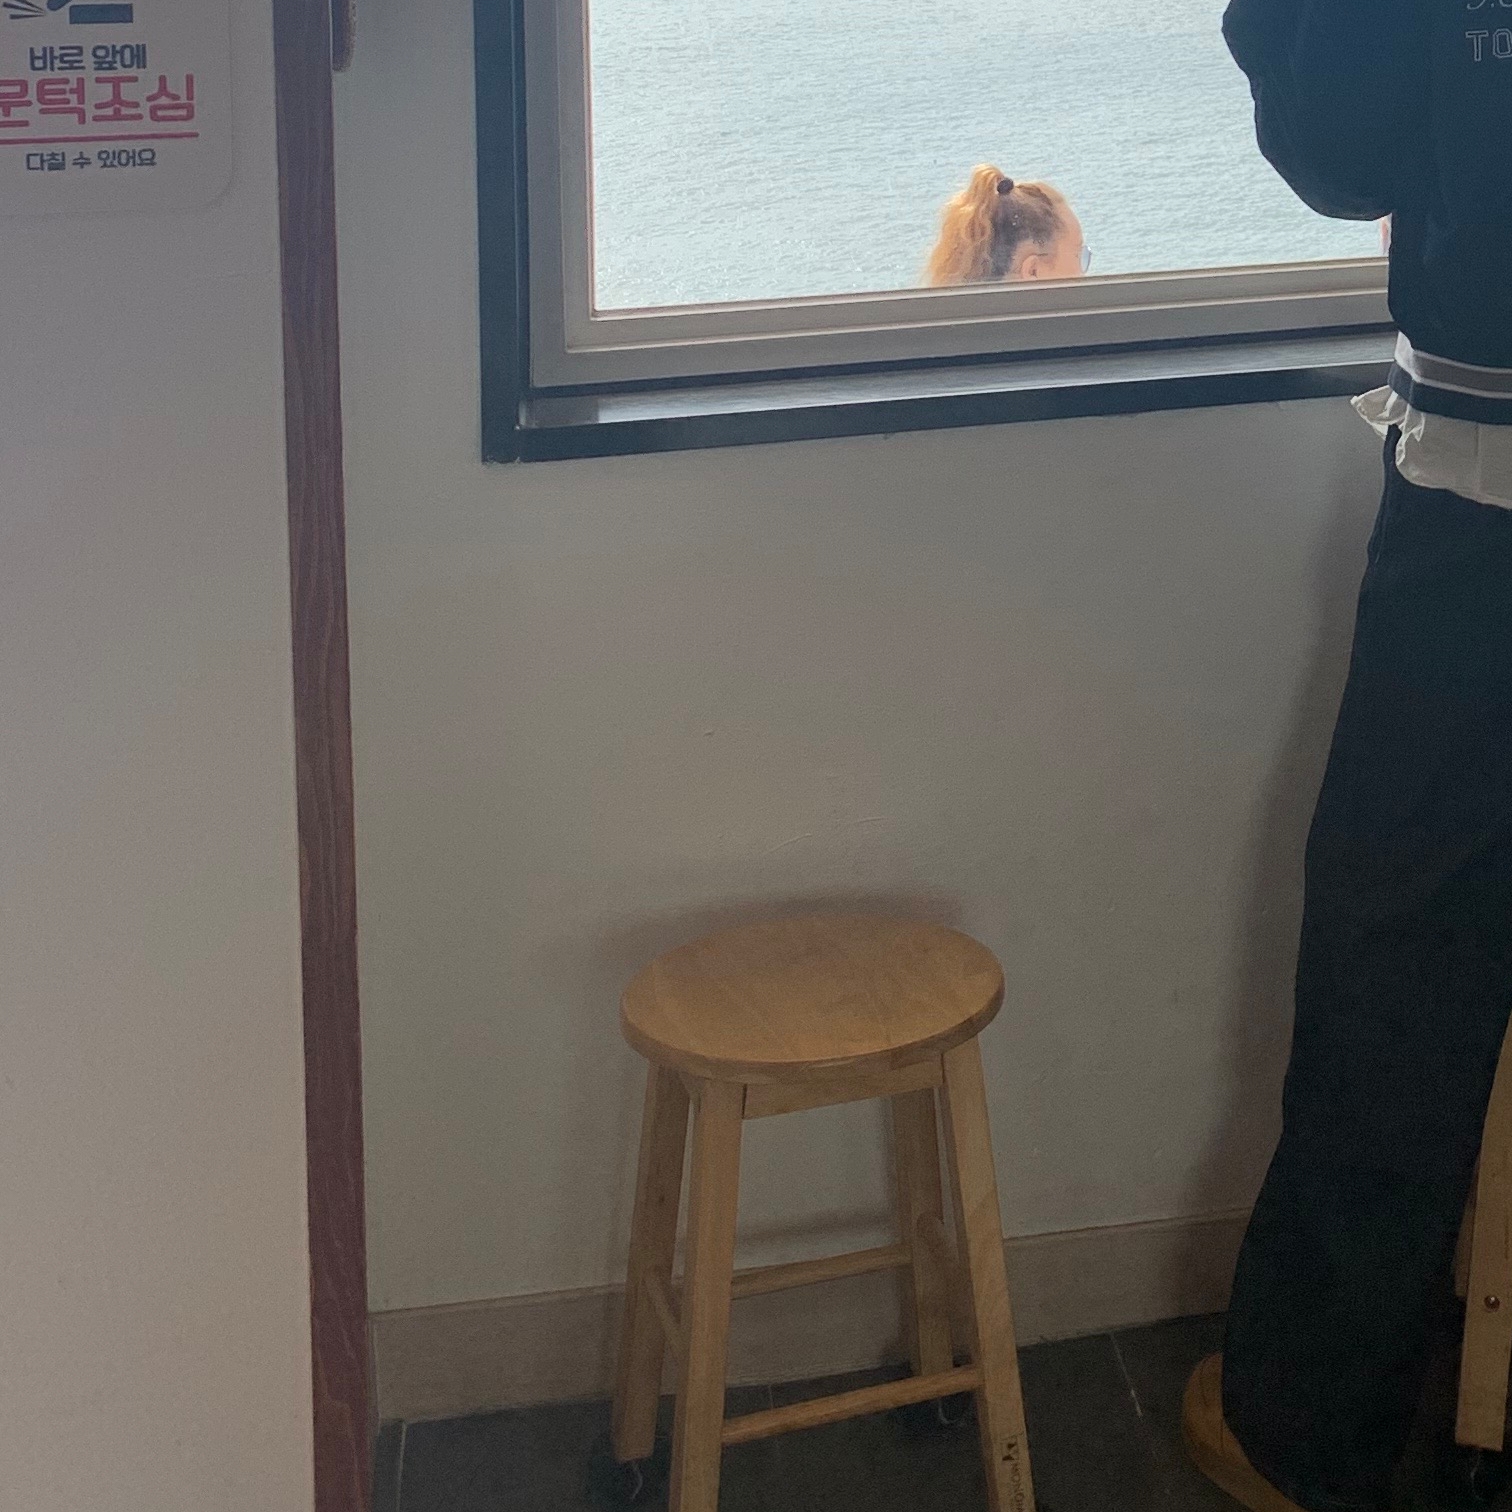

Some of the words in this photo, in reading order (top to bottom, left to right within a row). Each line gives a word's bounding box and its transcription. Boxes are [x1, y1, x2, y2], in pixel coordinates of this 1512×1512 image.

[29, 45, 86, 72] 바로
[91, 43, 147, 71] 앞에
[26, 151, 66, 171] 다칠
[72, 151, 92, 169] 수
[97, 147, 158, 169] 있어요
